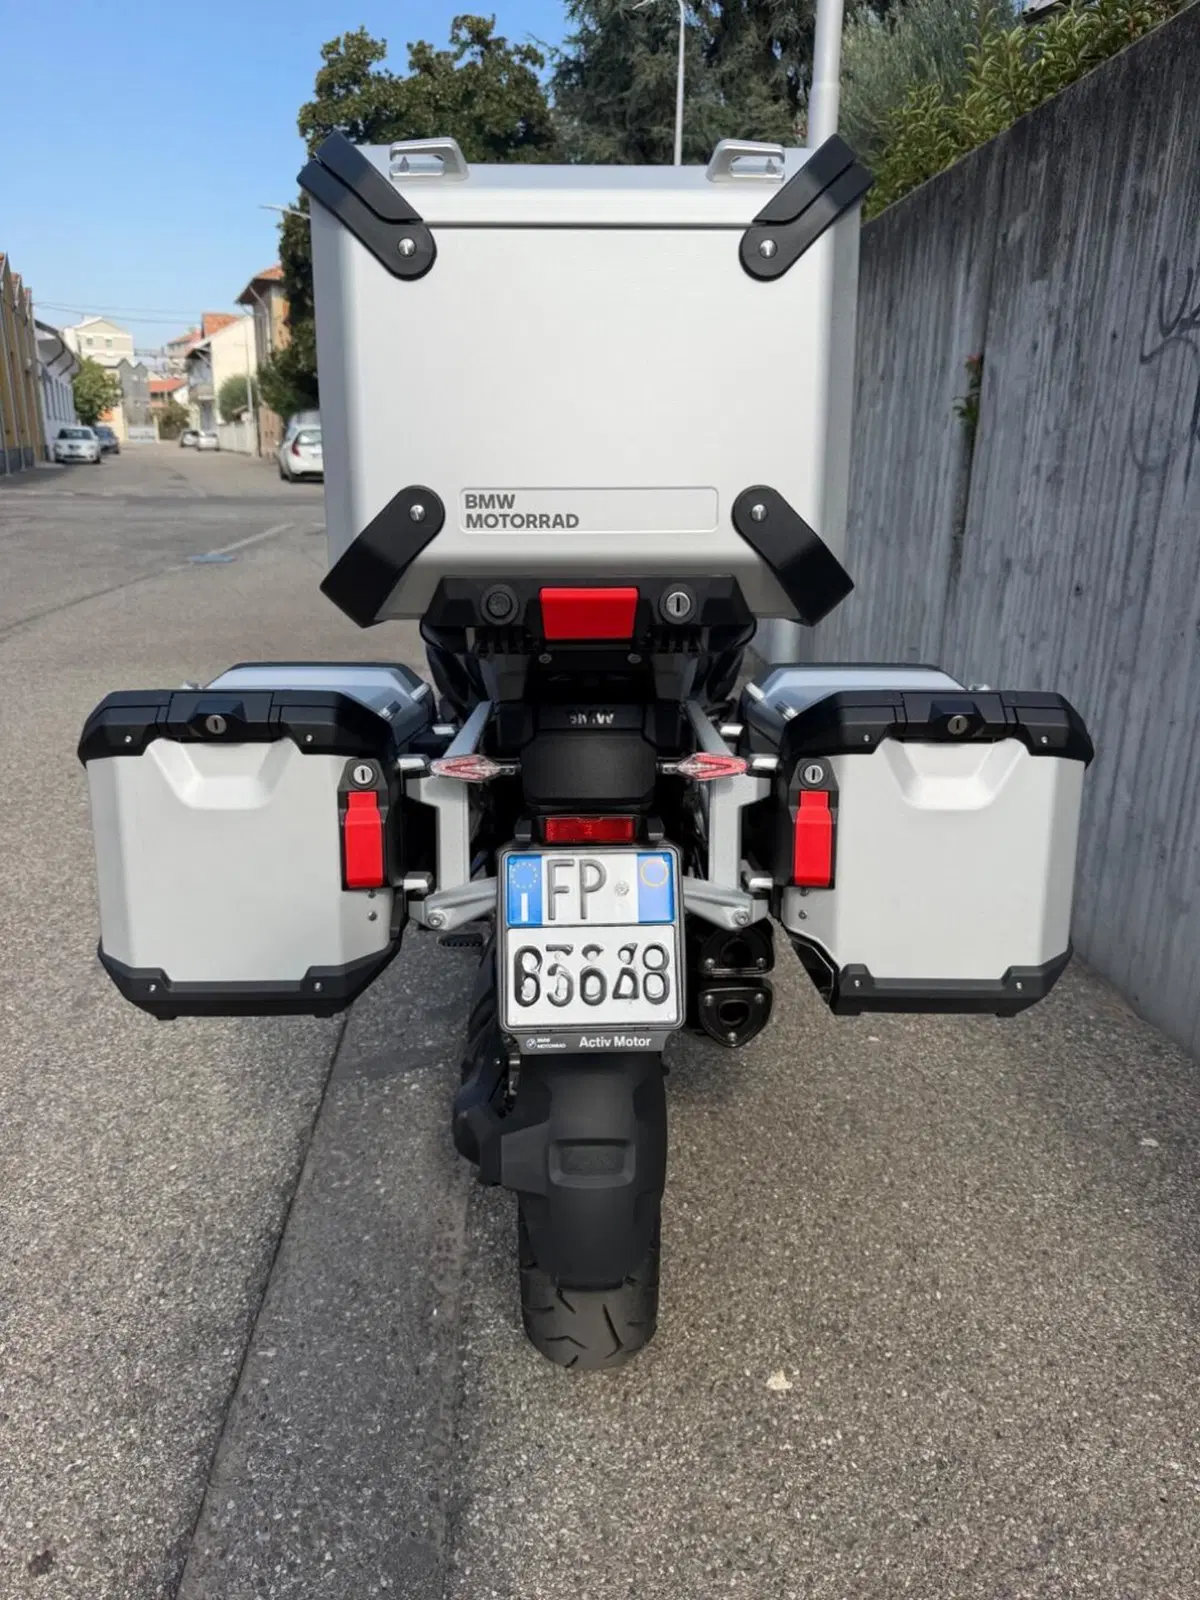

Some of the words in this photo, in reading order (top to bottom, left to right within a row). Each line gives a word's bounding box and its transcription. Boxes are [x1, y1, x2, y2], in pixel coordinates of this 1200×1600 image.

[465, 494, 515, 509] BMW
[466, 513, 579, 529] MOTORRAD
[547, 858, 608, 921] FP
[578, 1036, 612, 1049] Activ
[613, 1036, 652, 1048] Motor
